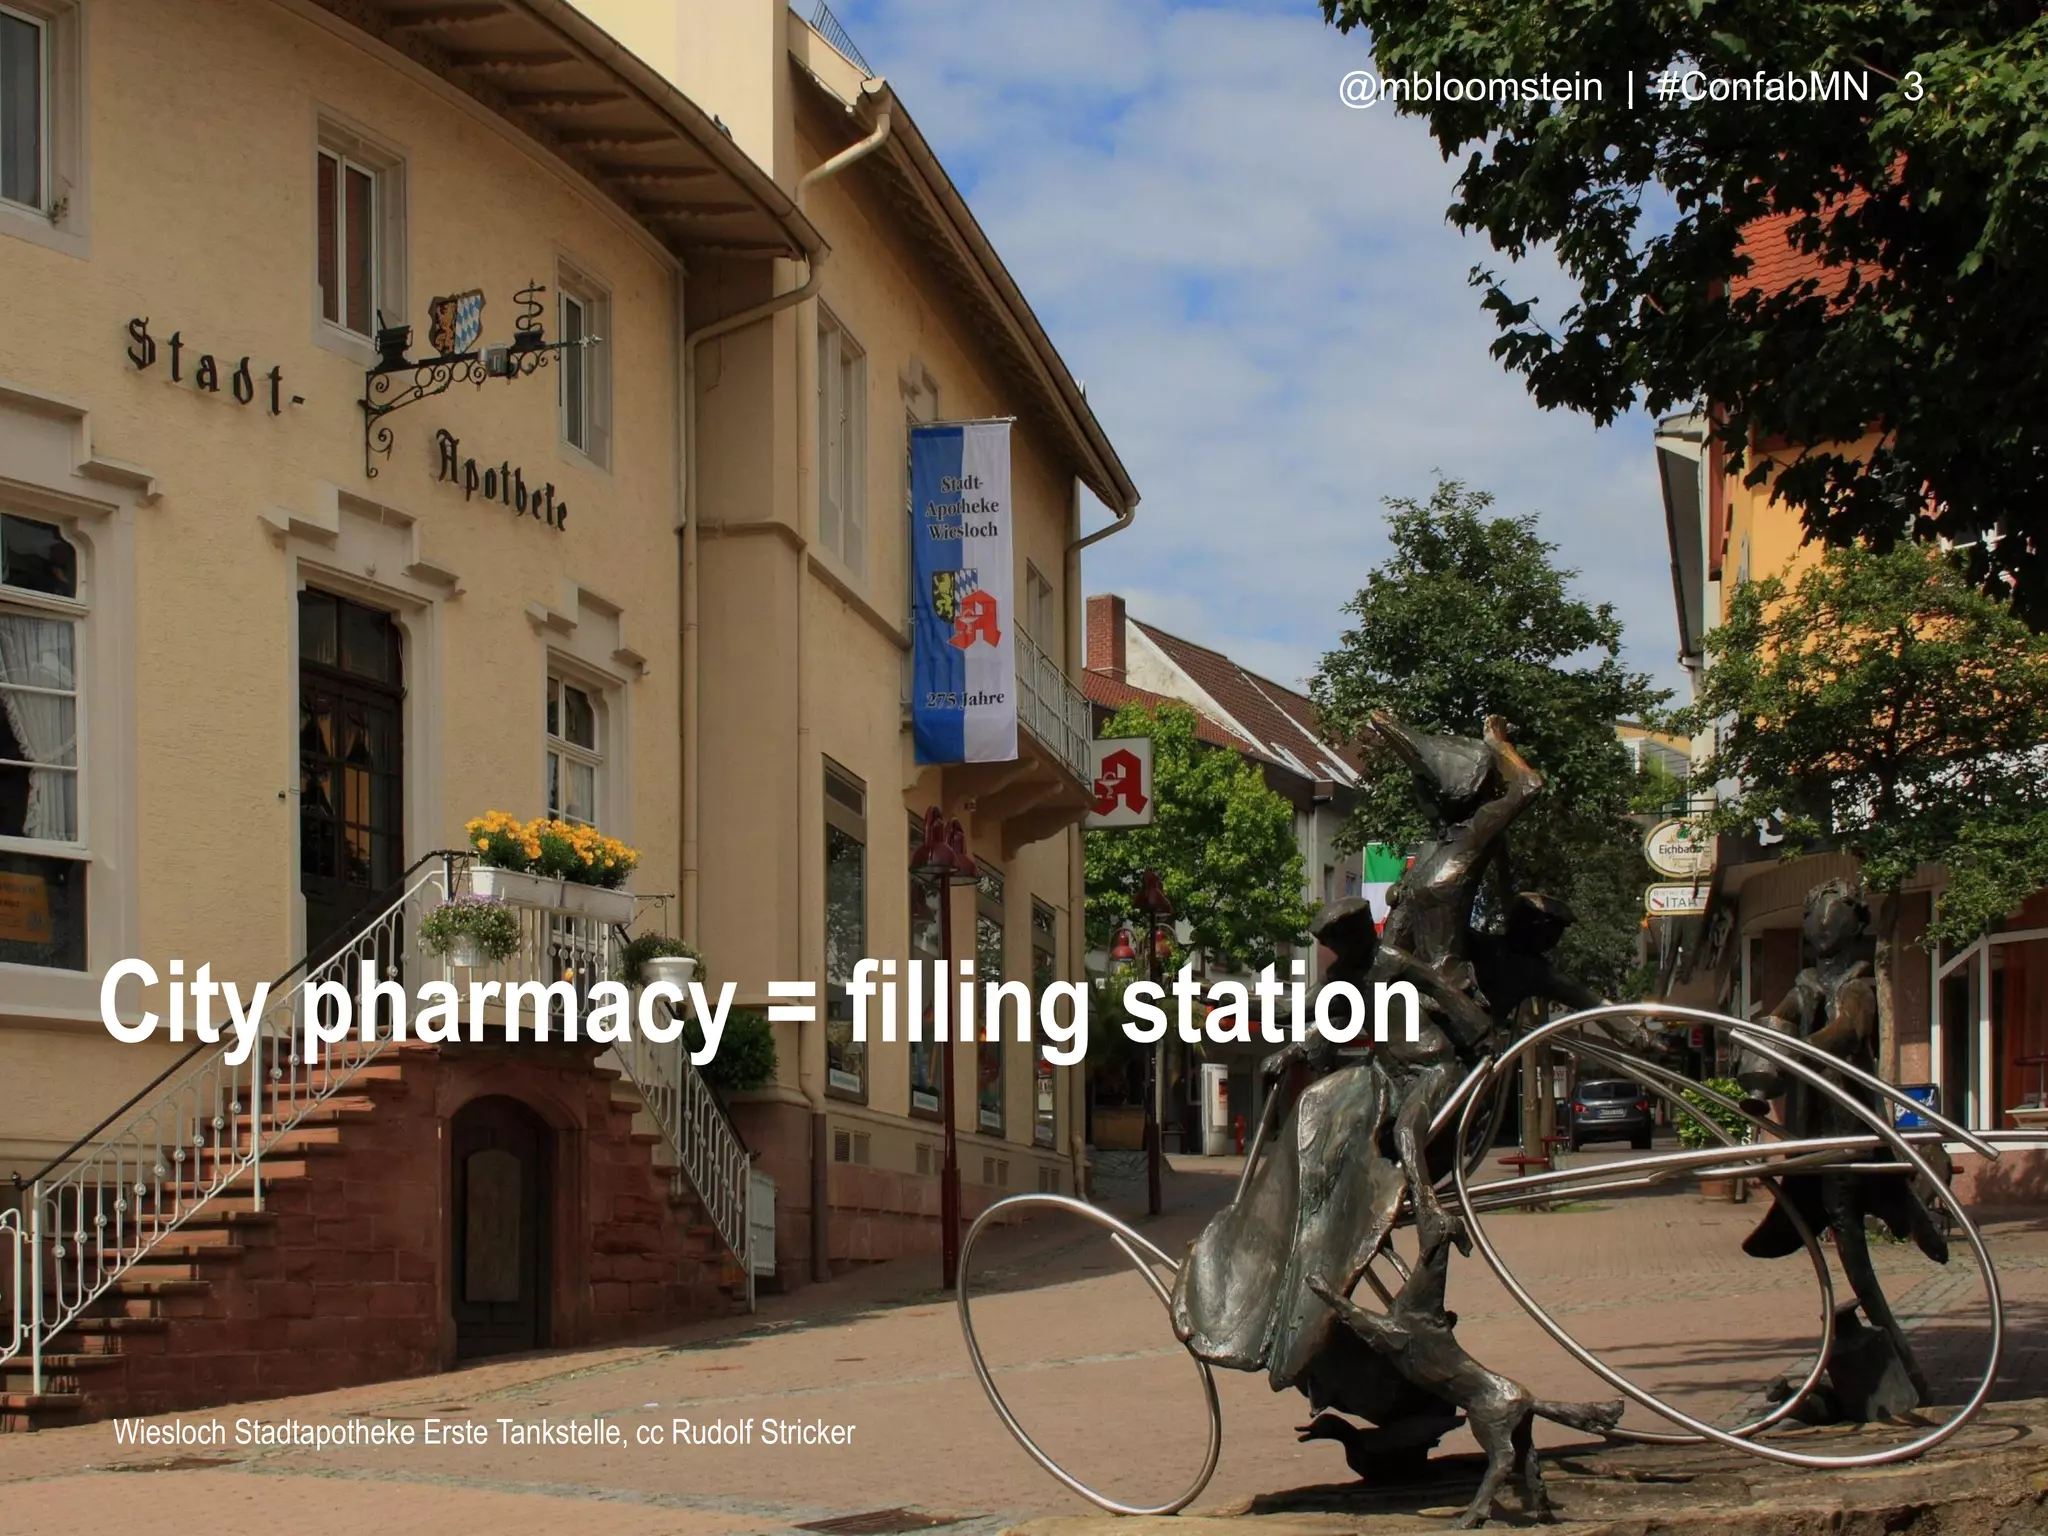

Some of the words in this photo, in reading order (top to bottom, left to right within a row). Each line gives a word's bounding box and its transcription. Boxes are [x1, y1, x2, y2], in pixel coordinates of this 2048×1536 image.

[127, 315, 305, 416] Stadt-
[436, 428, 568, 532] Apotheke
[940, 474, 984, 493] Stadt-
[926, 497, 1000, 520] Apotheke
[928, 521, 999, 541] Wiesloch
[927, 692, 957, 709] 275
[959, 689, 1005, 710] Jahre
